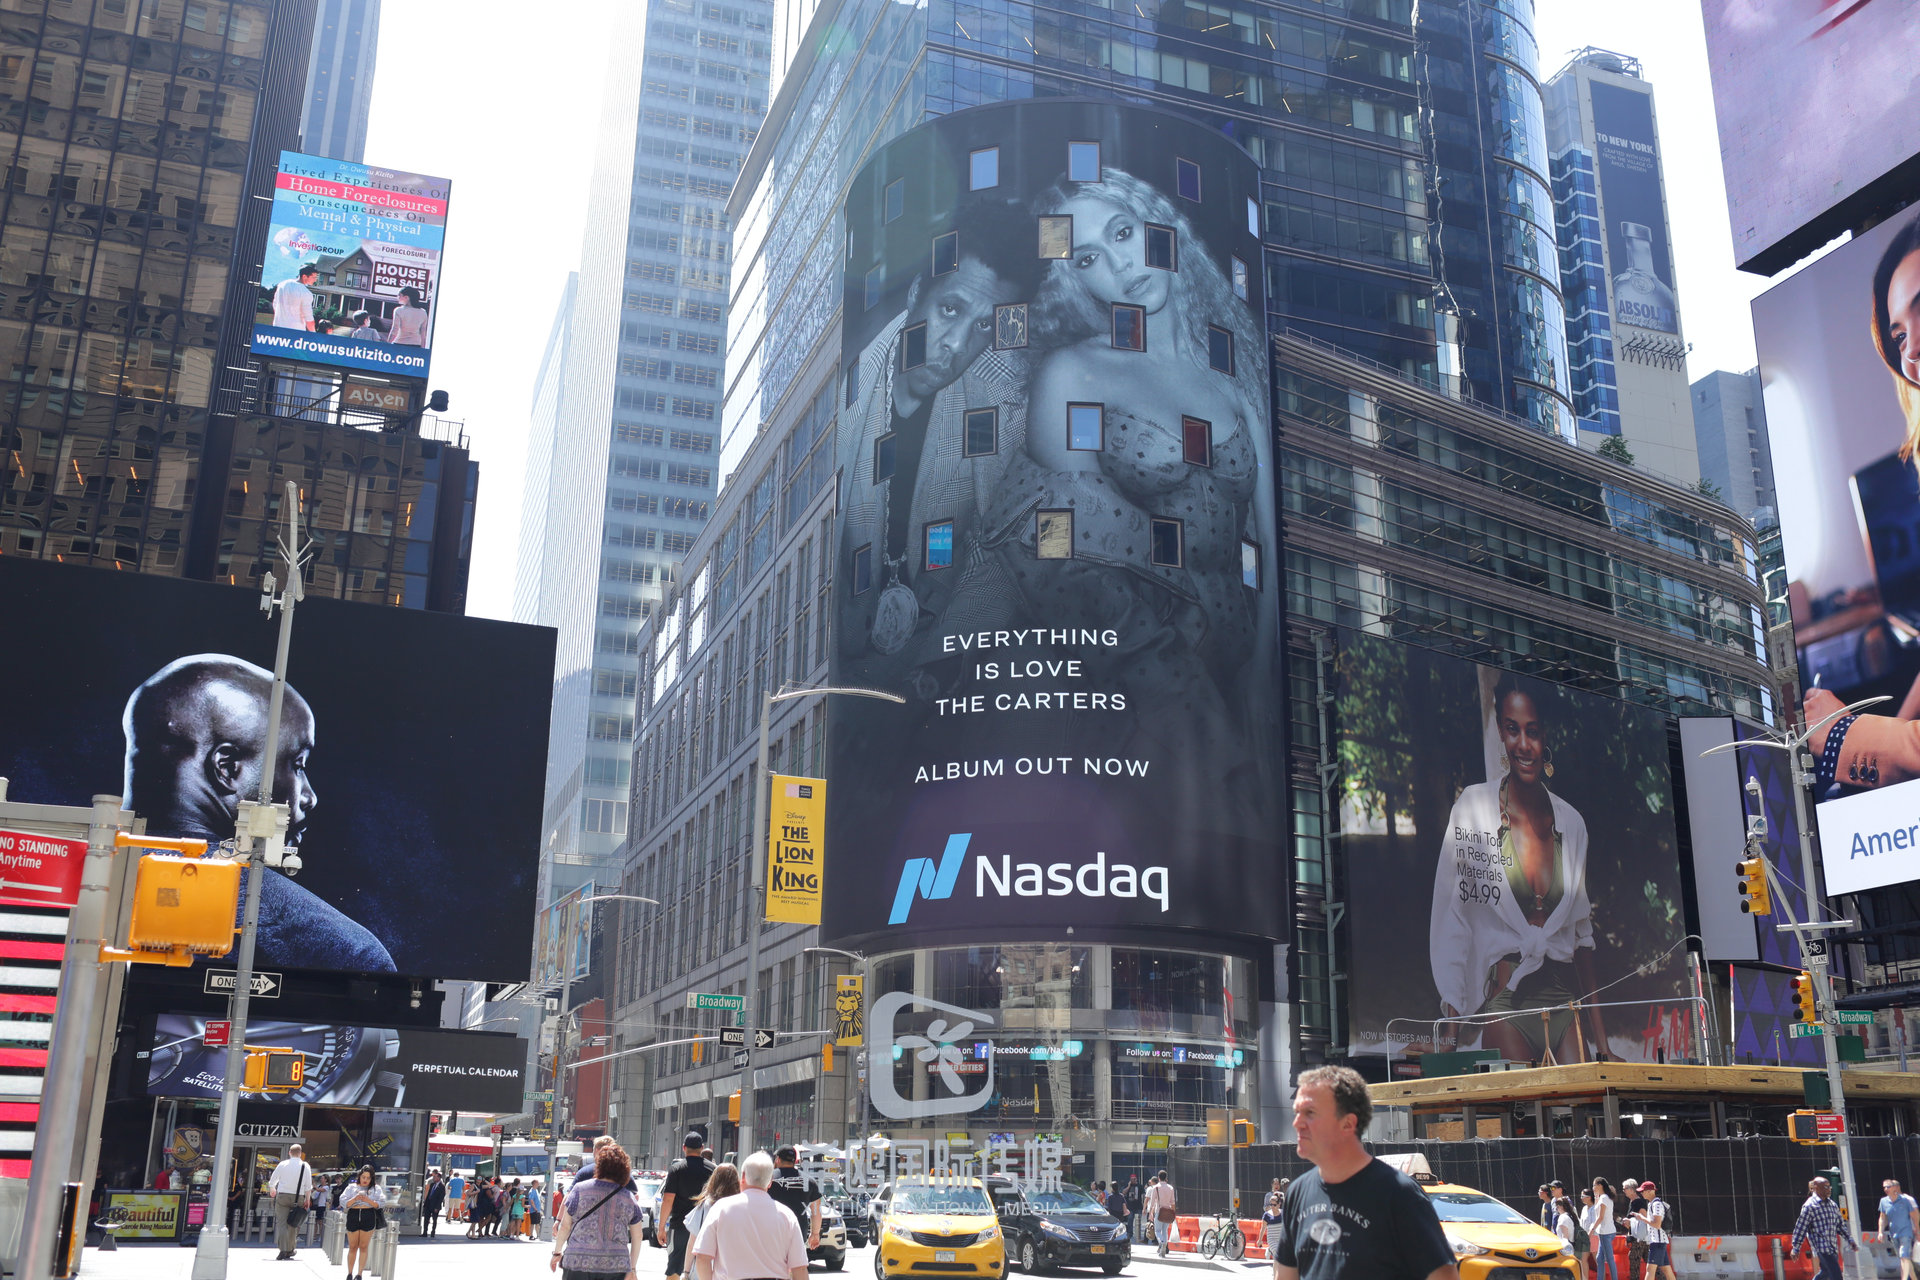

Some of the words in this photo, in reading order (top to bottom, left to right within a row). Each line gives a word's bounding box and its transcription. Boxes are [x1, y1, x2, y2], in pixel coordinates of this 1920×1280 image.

[1596, 132, 1608, 143] TO
[1609, 135, 1628, 148] NEW
[283, 163, 326, 179] Lived
[333, 171, 423, 197] Experiences
[430, 188, 448, 200] Of
[375, 169, 395, 179] Kizito
[288, 176, 337, 197] Home
[343, 186, 438, 214] Foreclosures
[297, 193, 399, 219] Consequences
[406, 212, 426, 223] On
[299, 205, 346, 223] Mental
[350, 214, 361, 225] &
[366, 215, 421, 236] Physical
[382, 246, 427, 258] FORECLOSURE
[376, 263, 426, 281] HOUSE
[375, 275, 397, 286] FOR
[400, 277, 426, 290] SALE
[256, 333, 425, 368] www.drowusukizito.com
[349, 388, 405, 408] Absen
[943, 629, 1118, 653] EVERYTHING
[976, 662, 1000, 680] IS
[1010, 660, 1082, 679] LOVE
[935, 695, 985, 716] THE
[995, 692, 1126, 711] CARTERS
[914, 759, 1004, 783] ALBUM
[1015, 757, 1073, 775] OUT
[1084, 758, 1149, 777] NOW
[782, 826, 808, 839] THE
[1455, 826, 1482, 844] Bikini
[1484, 832, 1503, 851] Top
[1850, 816, 1920, 860] Amer
[0, 836, 14, 850] NO
[18, 839, 68, 857] STANDING
[776, 841, 814, 864] LION
[1456, 844, 1465, 859] in
[1467, 846, 1513, 867] Recycled
[0, 852, 42, 869] Anytime
[772, 865, 818, 892] KING
[1457, 862, 1503, 882] Materials
[976, 852, 1169, 913] Nasdaq
[1459, 879, 1501, 906] $4.99
[1814, 955, 1827, 963] LANE
[217, 977, 237, 987] ONE
[699, 995, 741, 1011] Broadway
[1840, 1013, 1871, 1023] Broadway
[727, 1033, 743, 1042] ONE
[1360, 1031, 1378, 1041] NOW
[1388, 1033, 1415, 1043] STORES
[1416, 1035, 1431, 1044] AND
[1641, 1005, 1690, 1062] H&M
[1797, 1025, 1804, 1035] W
[1807, 1025, 1815, 1035] 43
[1126, 1048, 1150, 1057] Follow
[291, 1061, 302, 1081] 8
[412, 1063, 467, 1076] PERPETUAL
[468, 1067, 519, 1078] CALENDAR
[960, 1064, 984, 1072] CITIES
[526, 1093, 551, 1101] BROADWAY
[238, 1123, 300, 1138] CITIZEN
[1330, 1203, 1371, 1229] BANKS
[139, 1223, 152, 1231] King
